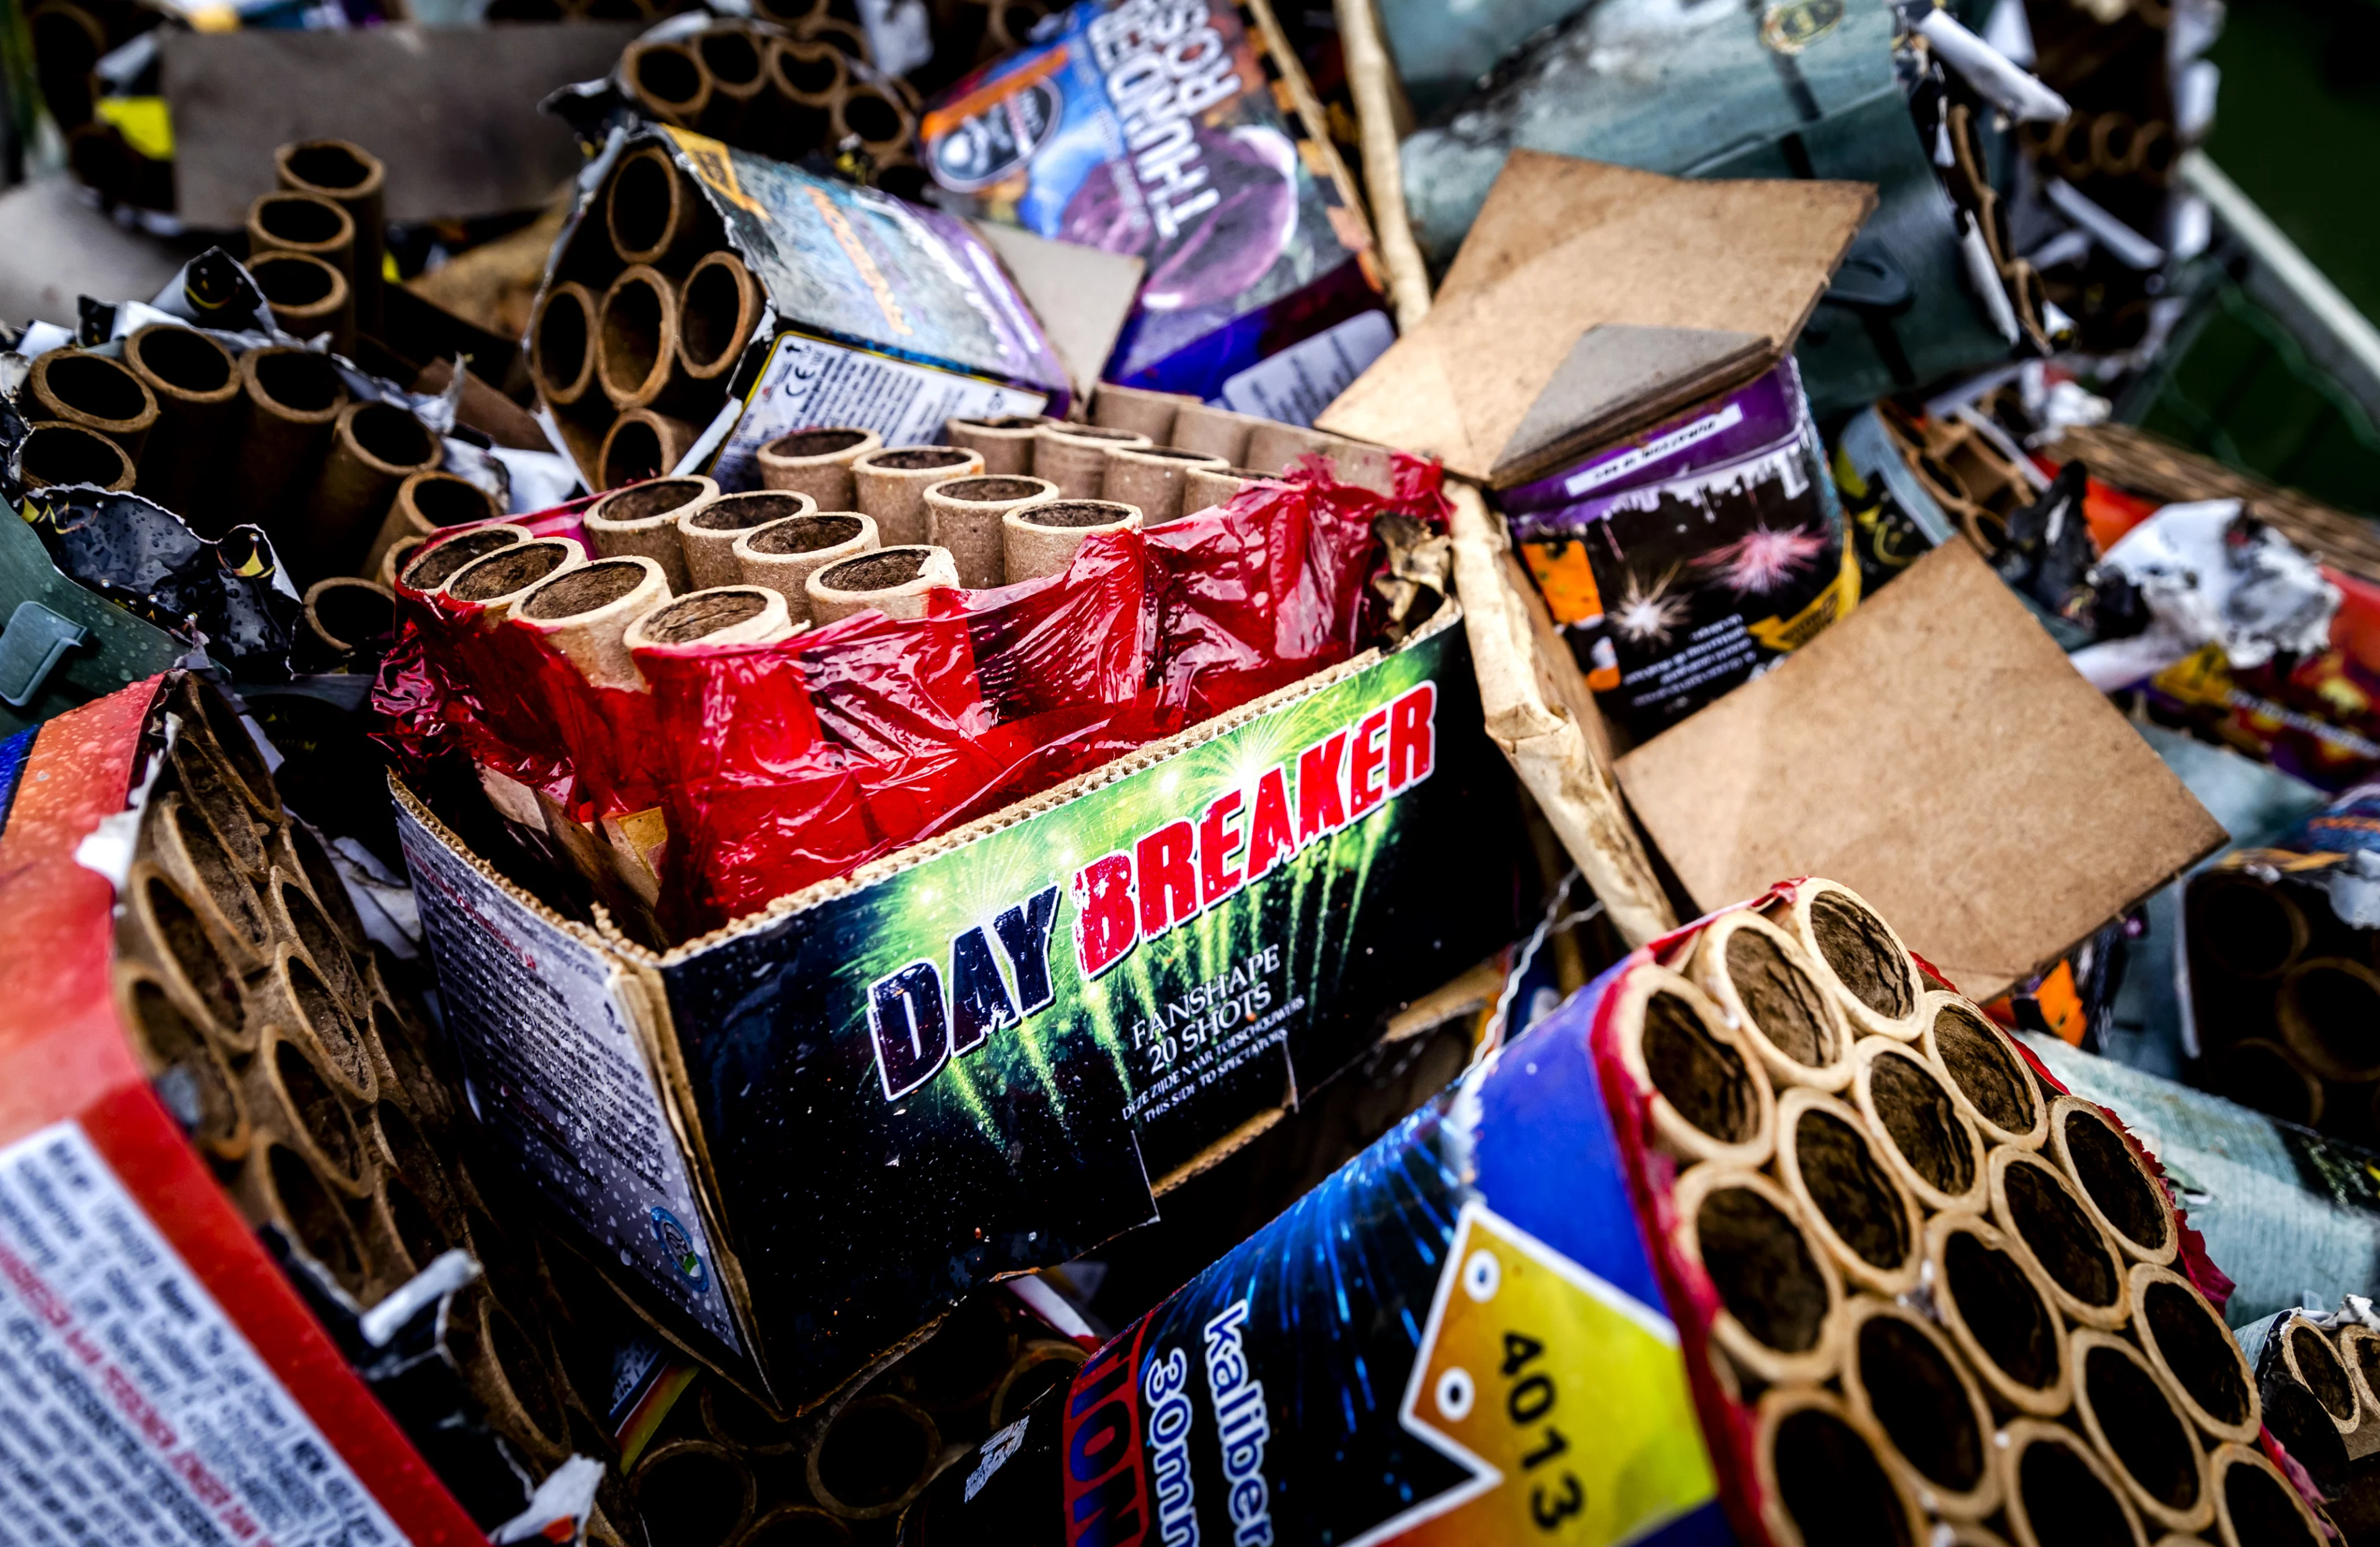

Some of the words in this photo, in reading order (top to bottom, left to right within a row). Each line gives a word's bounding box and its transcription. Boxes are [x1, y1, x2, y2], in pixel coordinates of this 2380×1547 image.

[1088, 0, 1220, 239] THUNDER
[868, 881, 1060, 1102] DAY
[1070, 679, 1438, 981] BREAKER
[1131, 943, 1280, 1051] FANSHAPE
[1144, 1101, 1170, 1122] THIS
[1198, 1069, 1217, 1087] TO
[1148, 1036, 1178, 1075] 20
[1181, 981, 1272, 1052] SHOTS
[1204, 1300, 1274, 1547] kaliber
[1501, 1329, 1586, 1533] 4013
